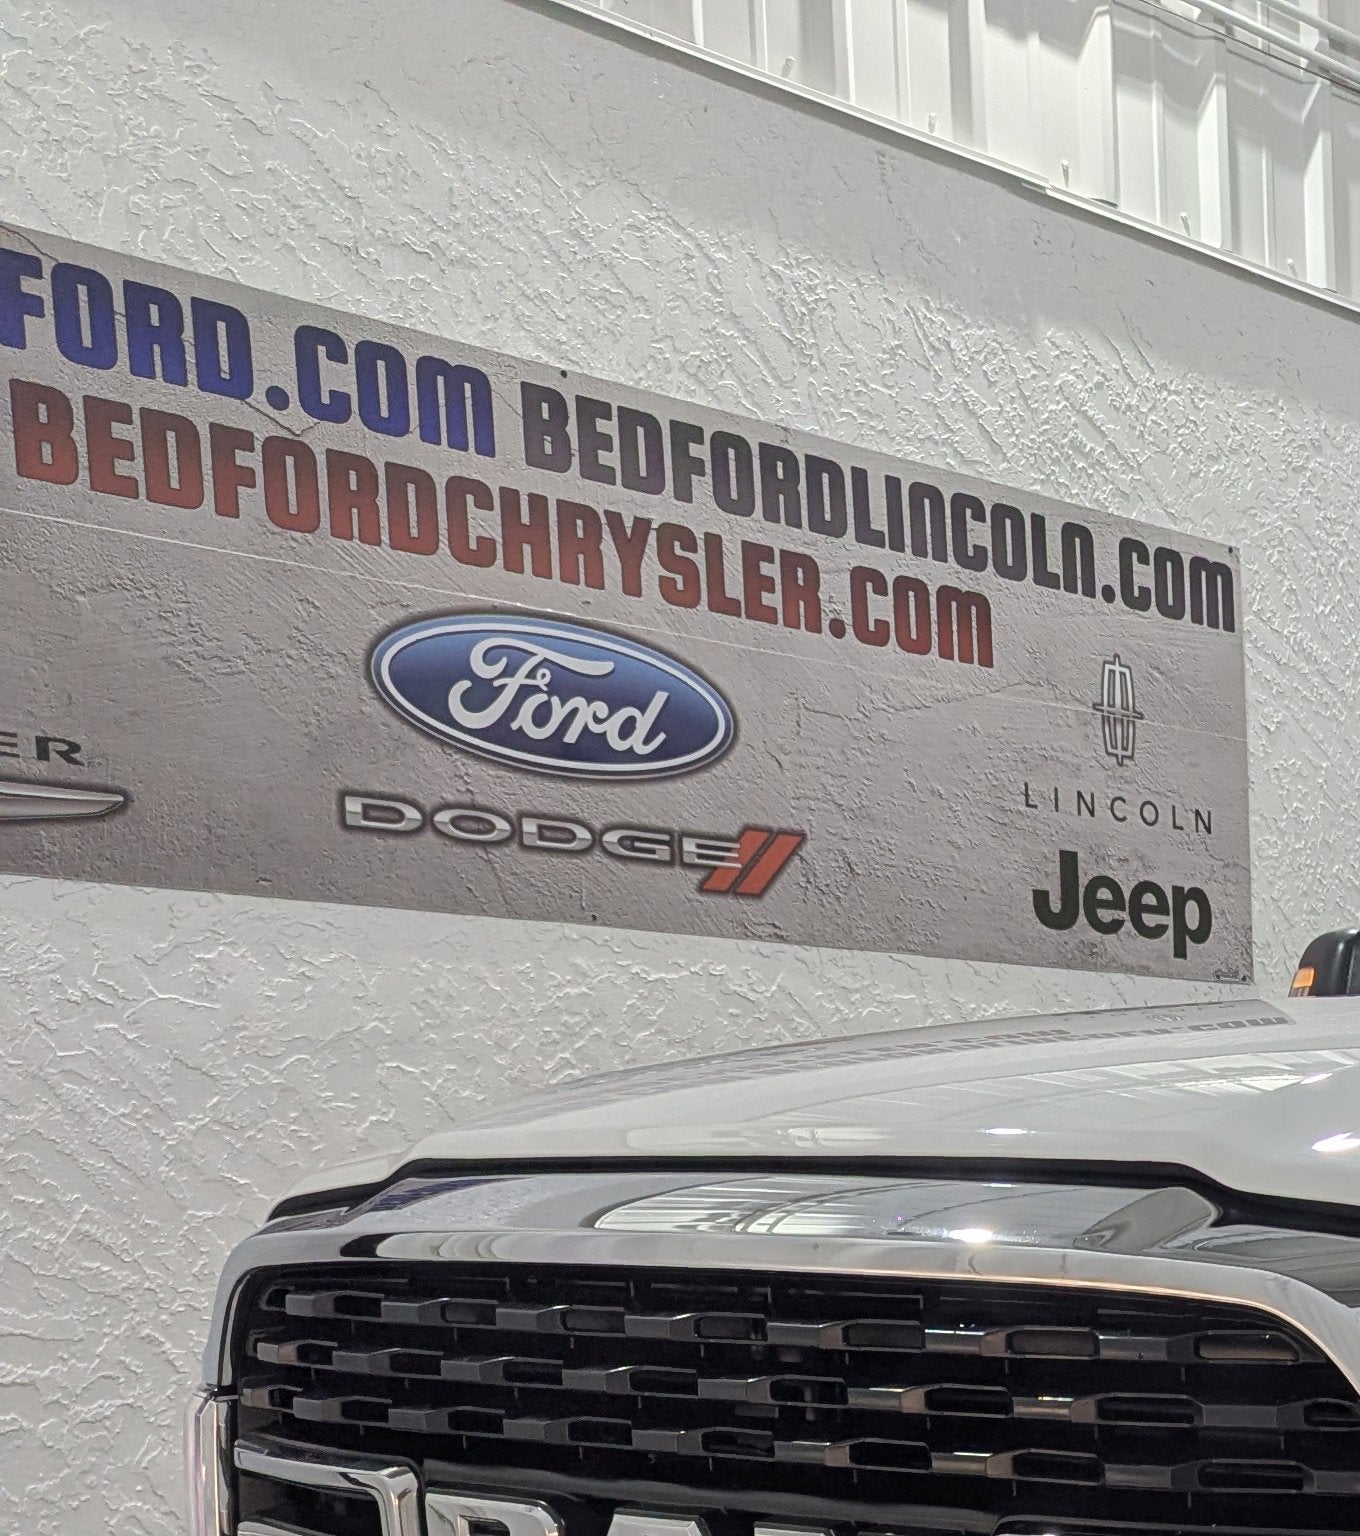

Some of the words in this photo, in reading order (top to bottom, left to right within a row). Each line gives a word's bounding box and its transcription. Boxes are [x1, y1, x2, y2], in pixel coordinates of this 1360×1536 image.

[0, 247, 497, 458] FORD.COM
[520, 379, 1237, 633] BEDFORDLINCOLN.COM
[8, 377, 995, 669] BEDFORDCHRYSLER.COM
[447, 637, 669, 756] Ford
[344, 795, 743, 869] DODGE
[1025, 782, 1213, 836] LINCOLN
[1032, 849, 1213, 960] Jeep
